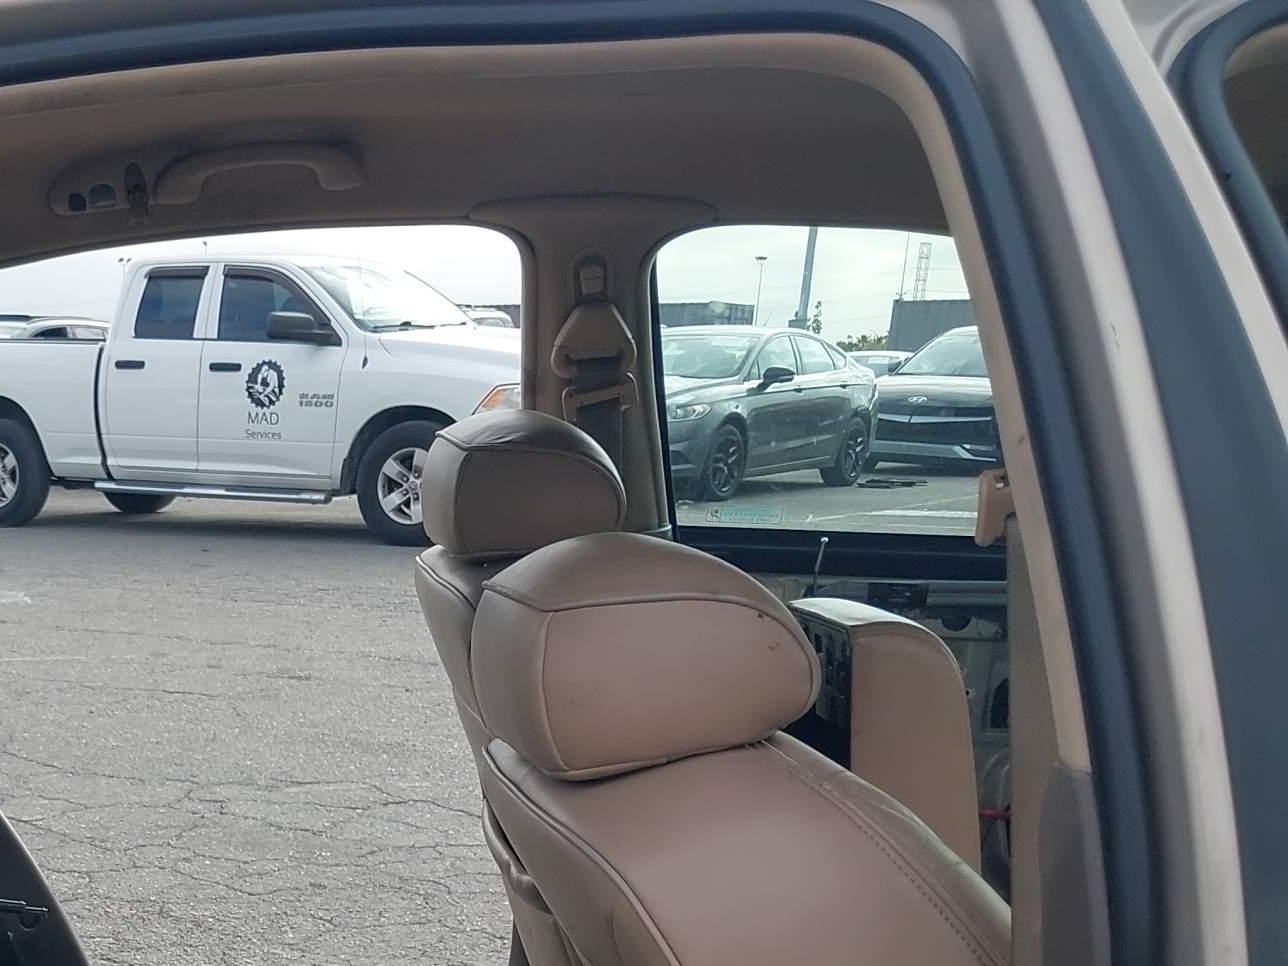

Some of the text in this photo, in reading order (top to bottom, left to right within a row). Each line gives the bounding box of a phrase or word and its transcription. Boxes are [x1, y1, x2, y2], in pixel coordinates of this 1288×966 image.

[298, 400, 334, 408] 1500
[247, 411, 280, 425] MAD
[244, 428, 282, 440] Services
